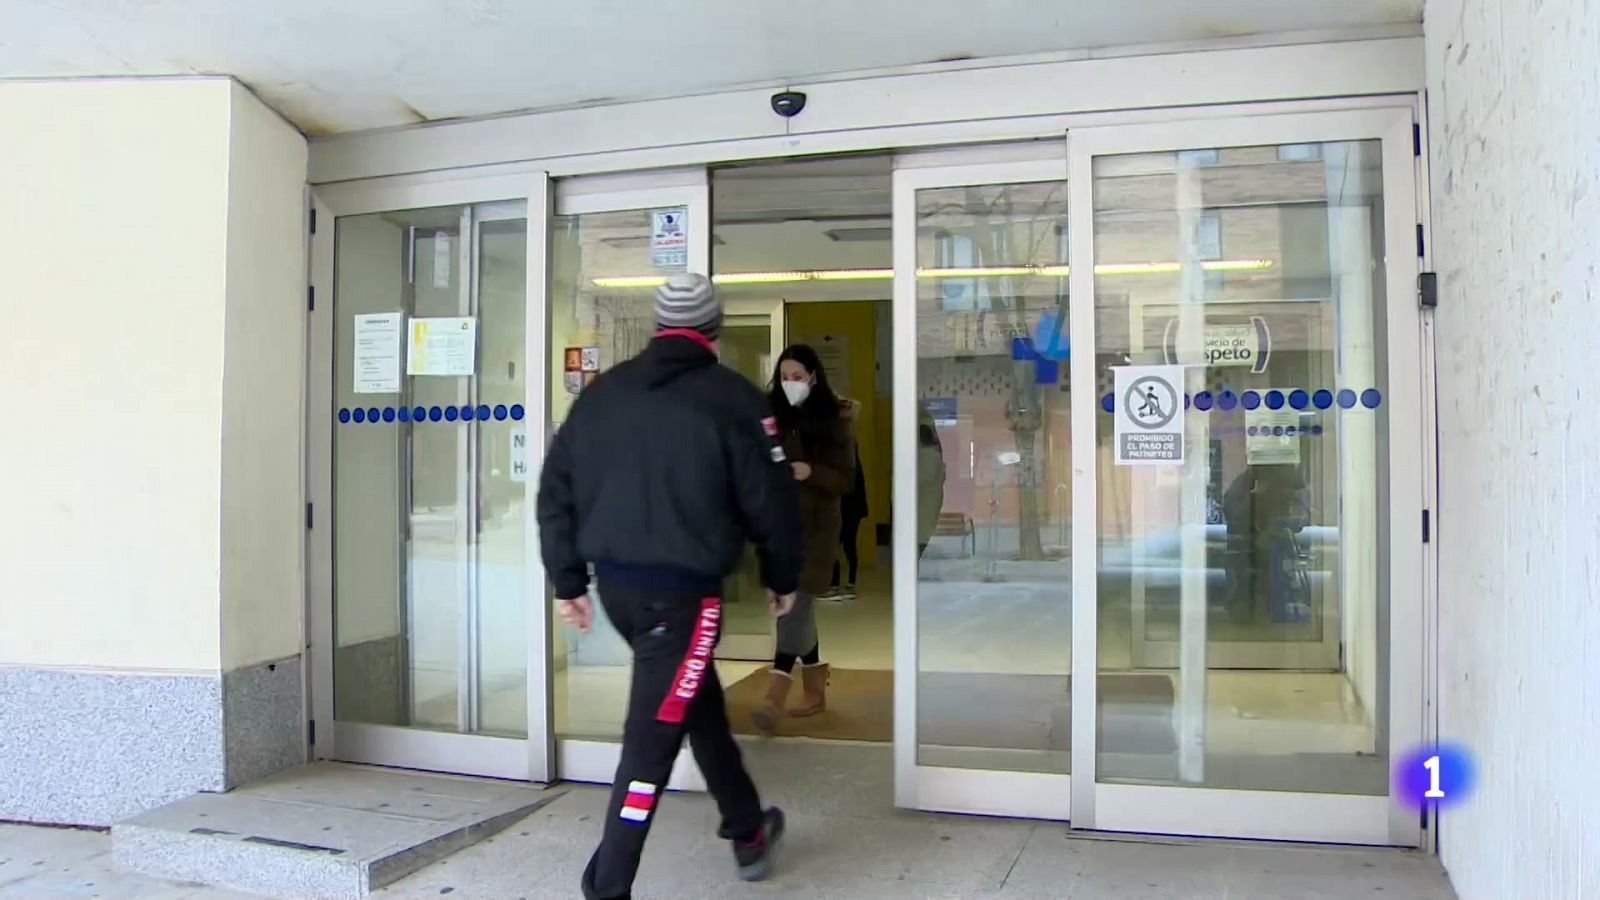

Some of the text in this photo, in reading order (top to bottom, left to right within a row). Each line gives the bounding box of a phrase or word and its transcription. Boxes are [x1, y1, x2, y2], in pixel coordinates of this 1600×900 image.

[1127, 434, 1175, 442] PROHIBIDO
[1126, 443, 1176, 451] EL PASO DE
[676, 659, 706, 699] ECKO
